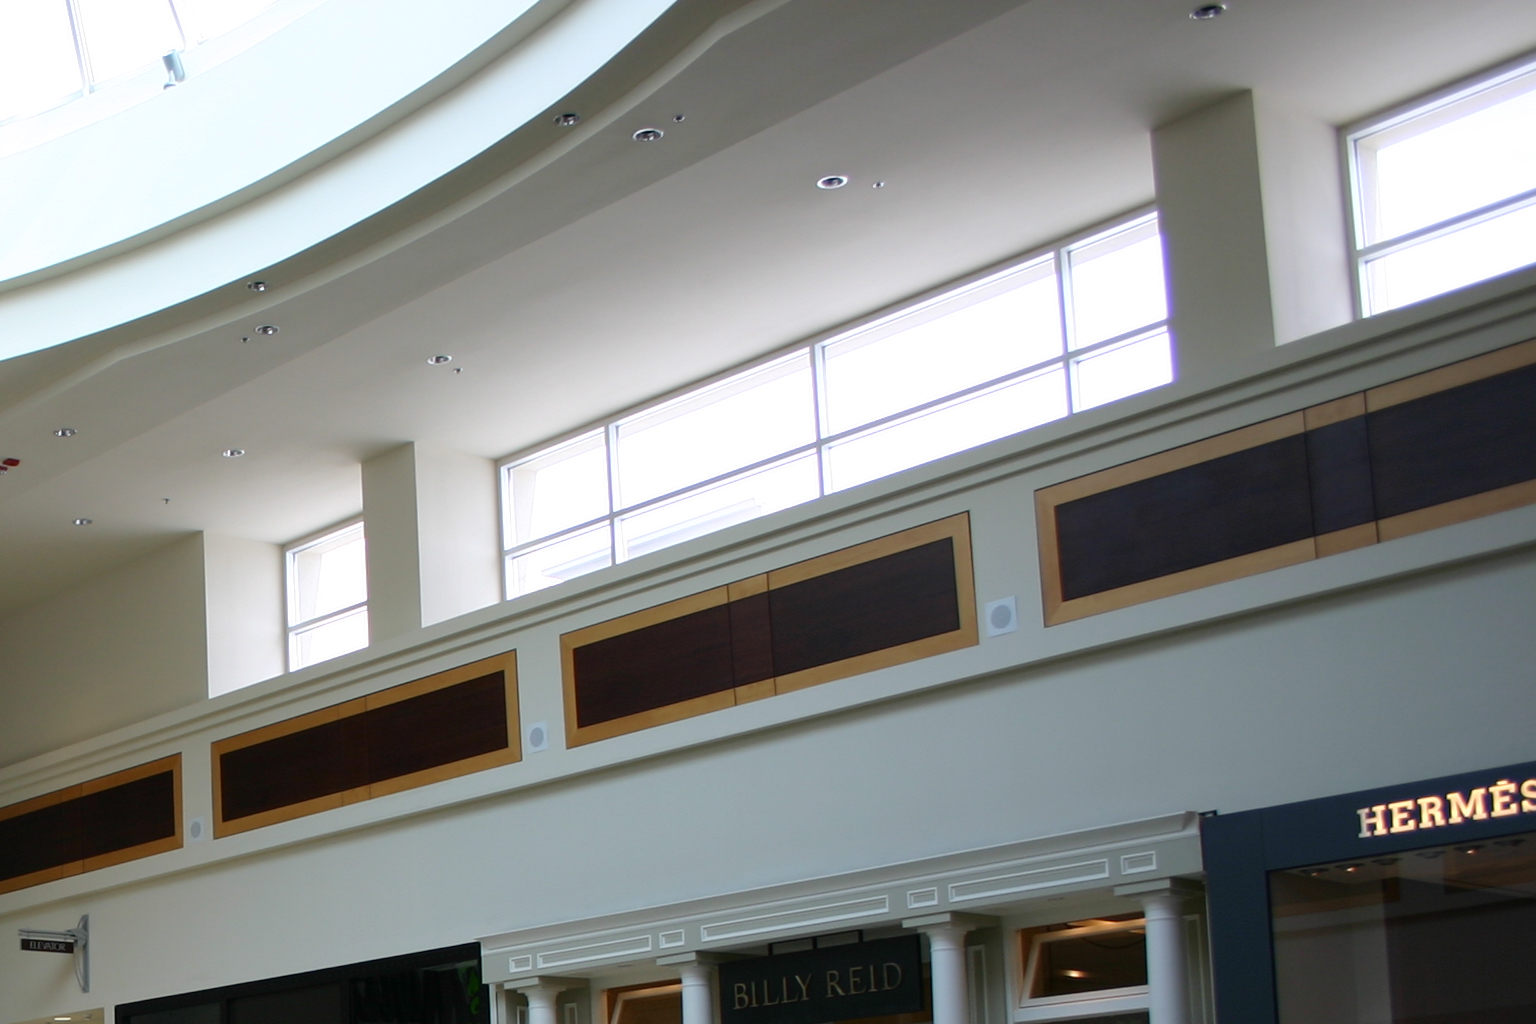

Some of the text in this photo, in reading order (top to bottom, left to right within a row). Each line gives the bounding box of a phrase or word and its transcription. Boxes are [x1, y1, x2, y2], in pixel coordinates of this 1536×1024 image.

[29, 941, 66, 951] ELEVATOR
[732, 962, 902, 1010] BILLY REID
